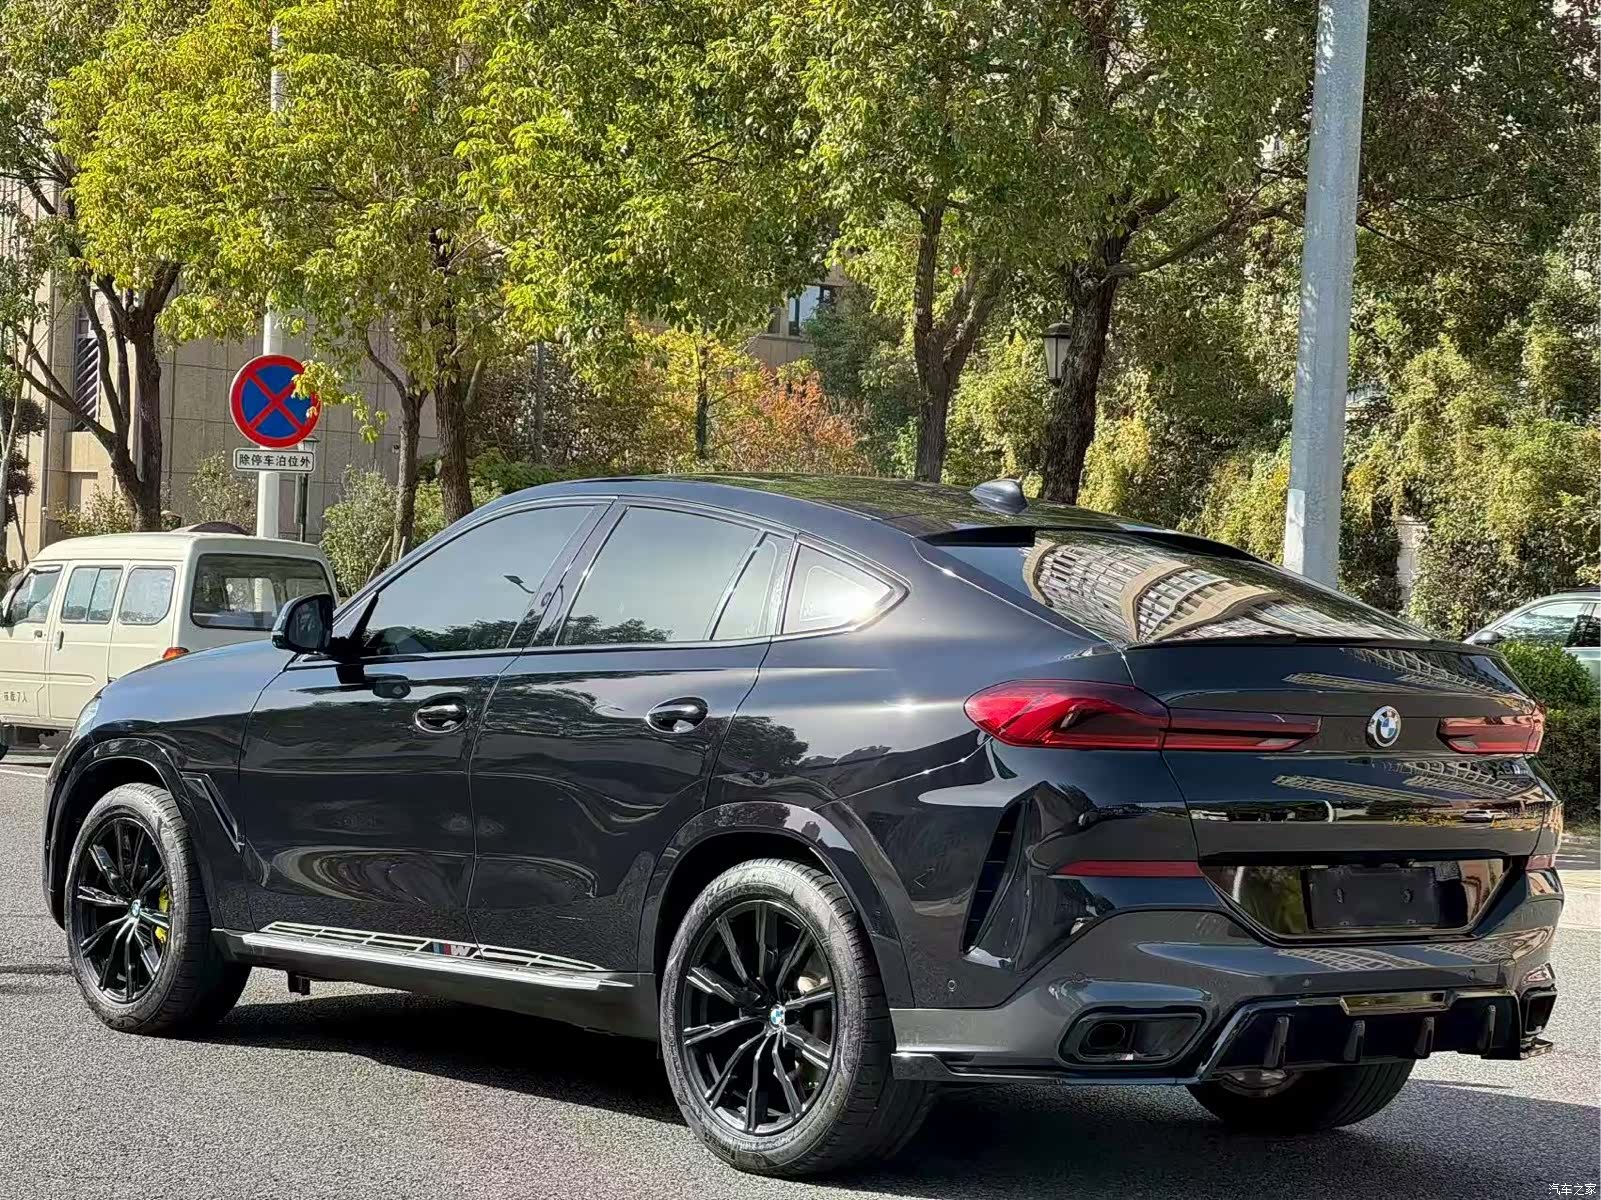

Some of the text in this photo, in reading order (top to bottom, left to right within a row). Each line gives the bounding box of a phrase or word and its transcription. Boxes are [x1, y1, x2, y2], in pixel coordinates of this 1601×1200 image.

[240, 453, 310, 467] 除停车泊位外
